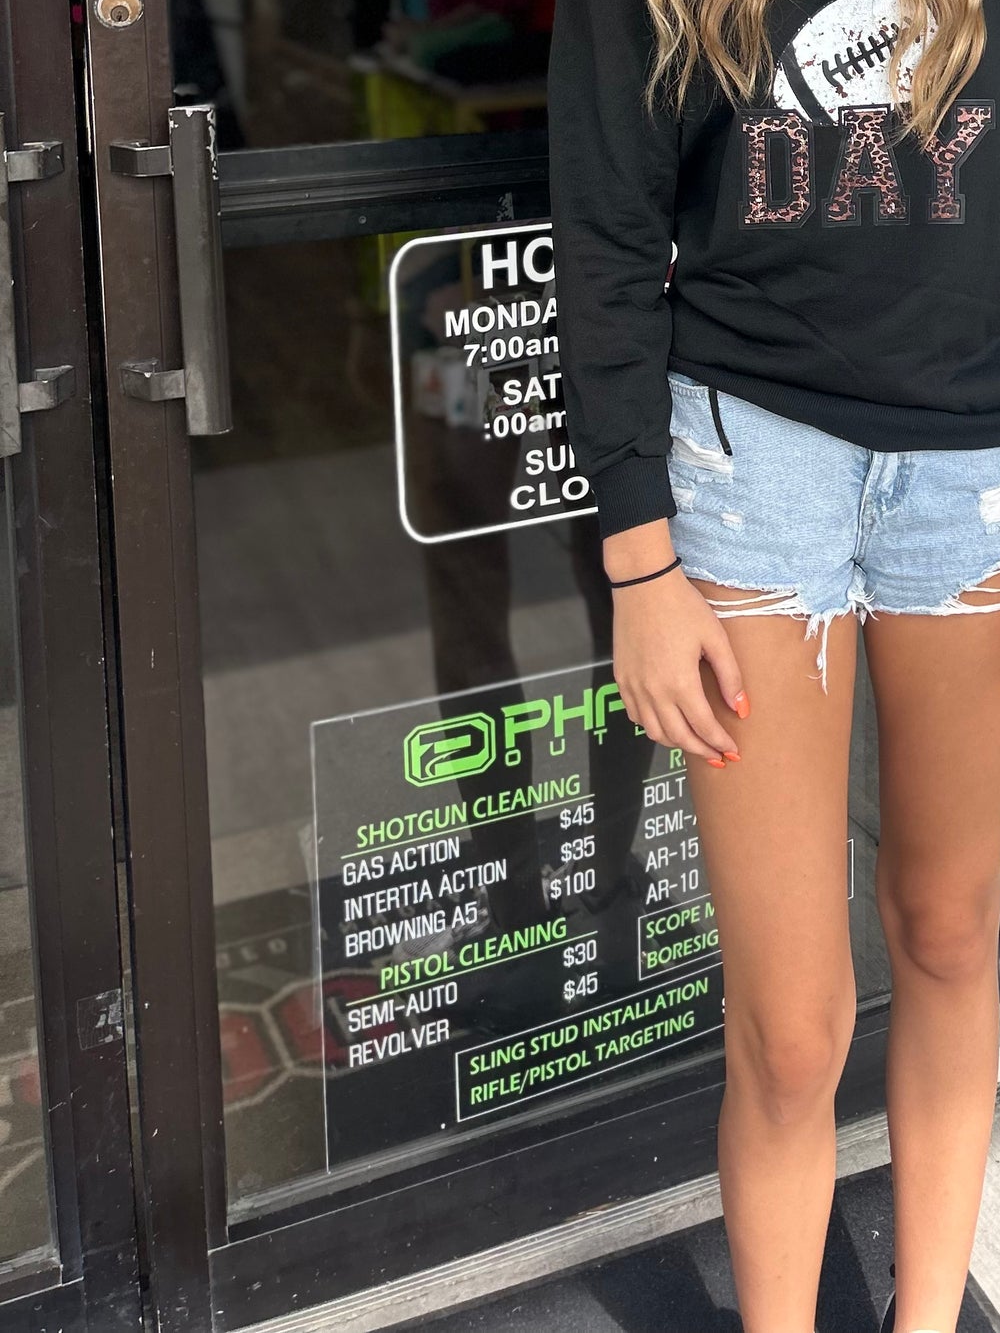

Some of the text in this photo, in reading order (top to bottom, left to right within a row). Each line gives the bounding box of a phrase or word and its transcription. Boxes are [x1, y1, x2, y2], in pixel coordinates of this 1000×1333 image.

[739, 101, 995, 227] DAY
[502, 372, 563, 406] SAT
[356, 774, 581, 849] SHOTGUN CLEANING
[643, 776, 687, 808] BOLT
[644, 809, 698, 840] SEMI-
[342, 802, 596, 887] GAS ACTION $45
[344, 835, 596, 923] INTERTIA ACTION $35
[645, 836, 699, 873] AR-15
[345, 868, 596, 958] BROWNING A5 $100
[645, 868, 699, 905] AR-10
[645, 905, 701, 939] SCOPE
[348, 939, 598, 1033] SEMI-AUTO $30
[380, 917, 568, 990] PISTOL CLEANING
[646, 928, 719, 970] BORESIG
[350, 972, 599, 1068] REVOLVER $45
[469, 1042, 526, 1076] SLING
[530, 1024, 579, 1056] STUD
[583, 977, 709, 1038] INSTALLATION
[470, 1010, 696, 1106] RIFLE/PISTOL TARGETING
